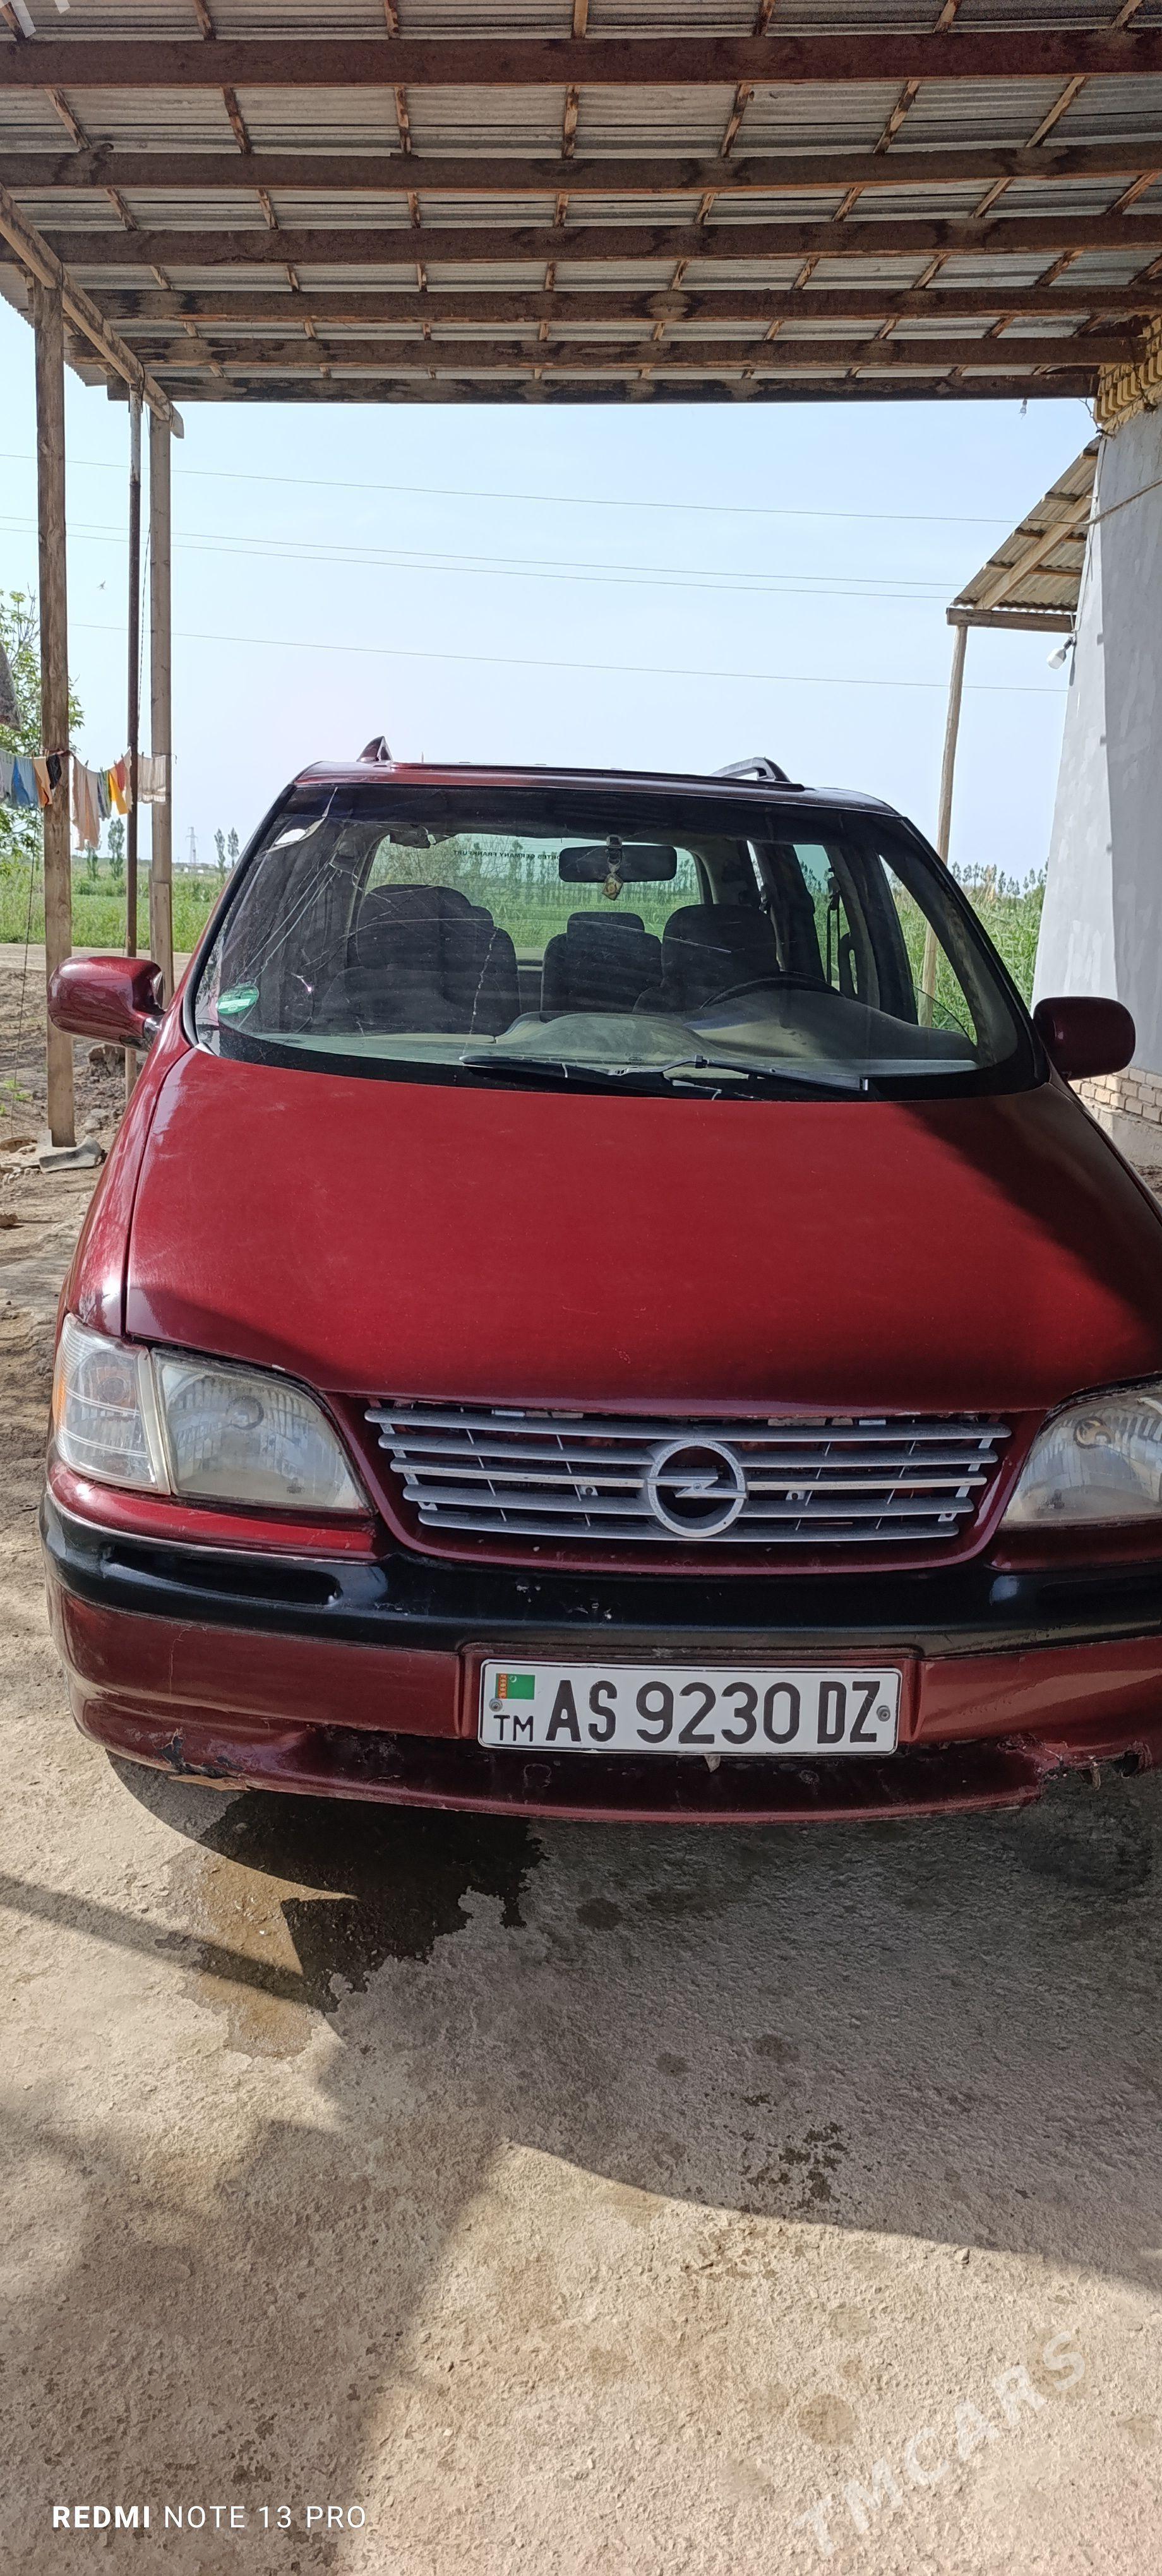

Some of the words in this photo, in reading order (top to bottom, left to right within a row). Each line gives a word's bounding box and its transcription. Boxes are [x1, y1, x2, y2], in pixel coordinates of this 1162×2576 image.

[494, 1714, 534, 1742] TM
[546, 1679, 618, 1743] AS
[635, 1681, 801, 1744] 9230
[817, 1681, 881, 1743] DZ
